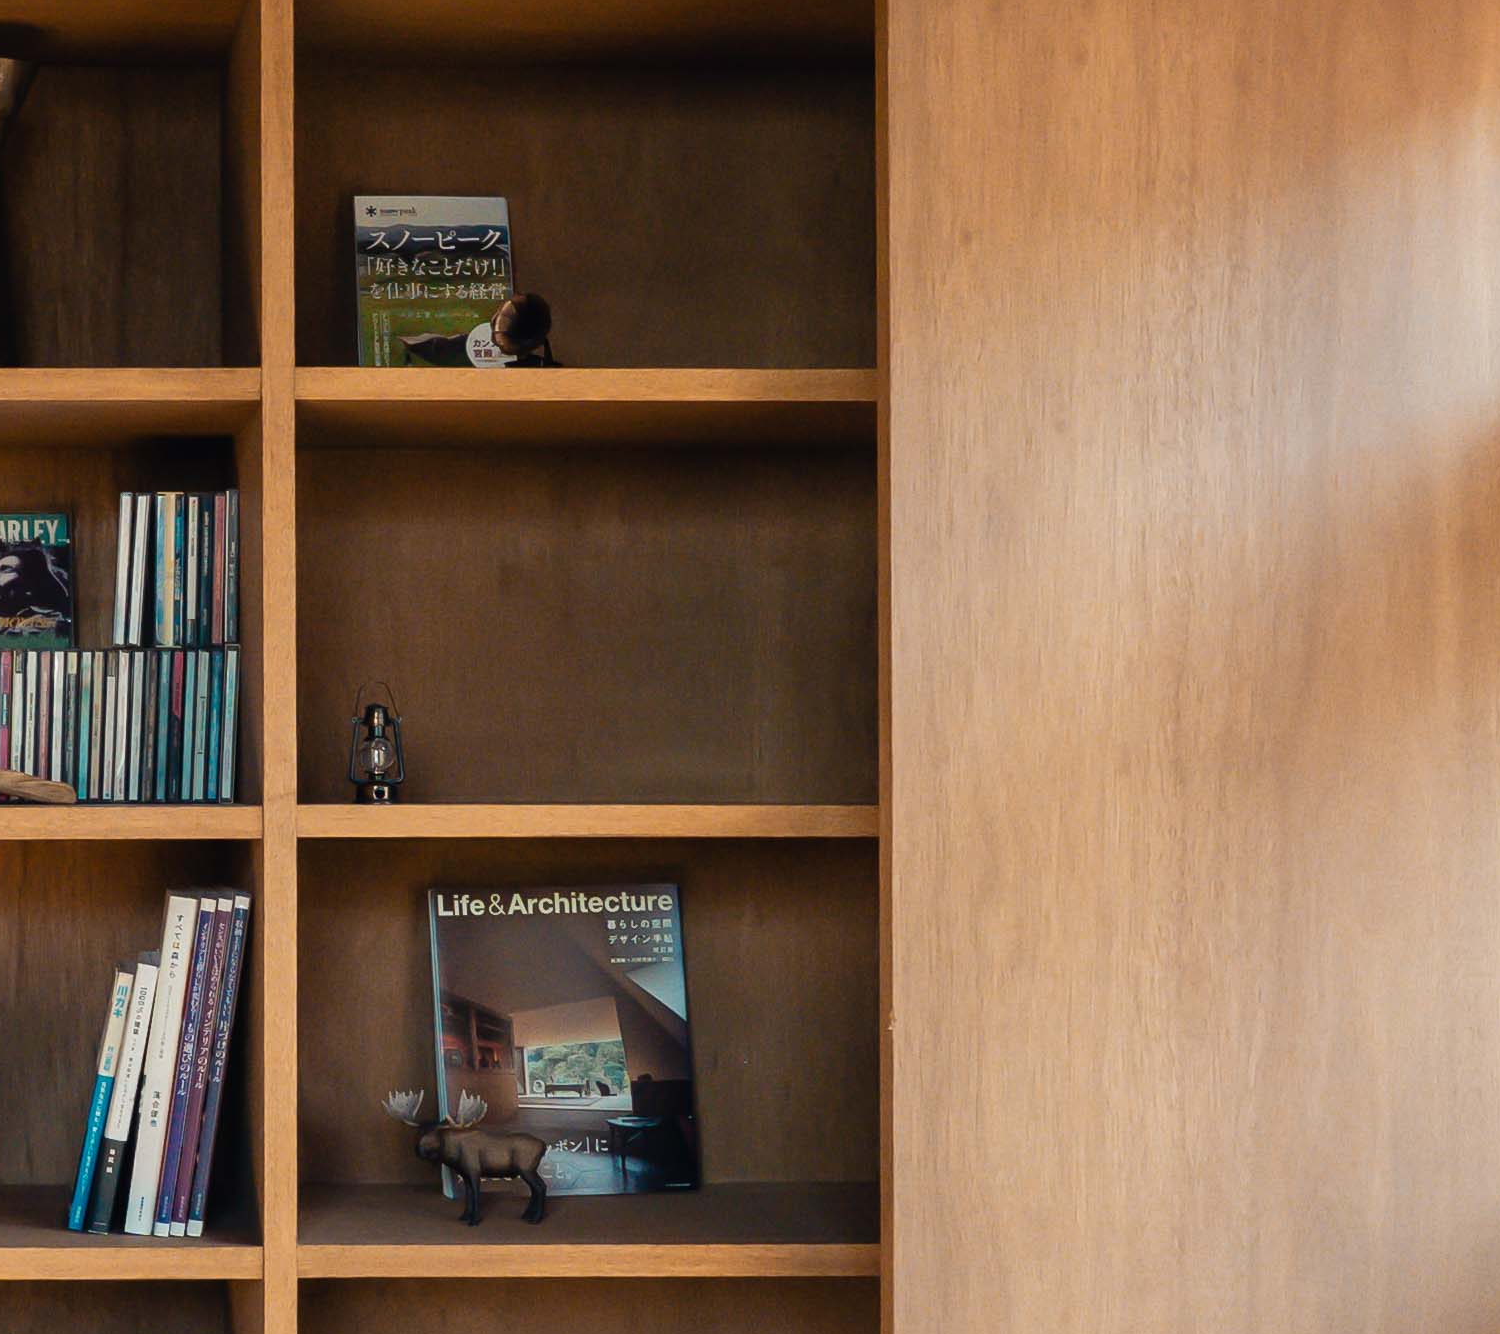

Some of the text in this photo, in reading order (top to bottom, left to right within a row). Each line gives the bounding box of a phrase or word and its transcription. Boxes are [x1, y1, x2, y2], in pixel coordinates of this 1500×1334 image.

[365, 230, 502, 251] スノーピーク
[370, 283, 507, 300] を仕事にする経営
